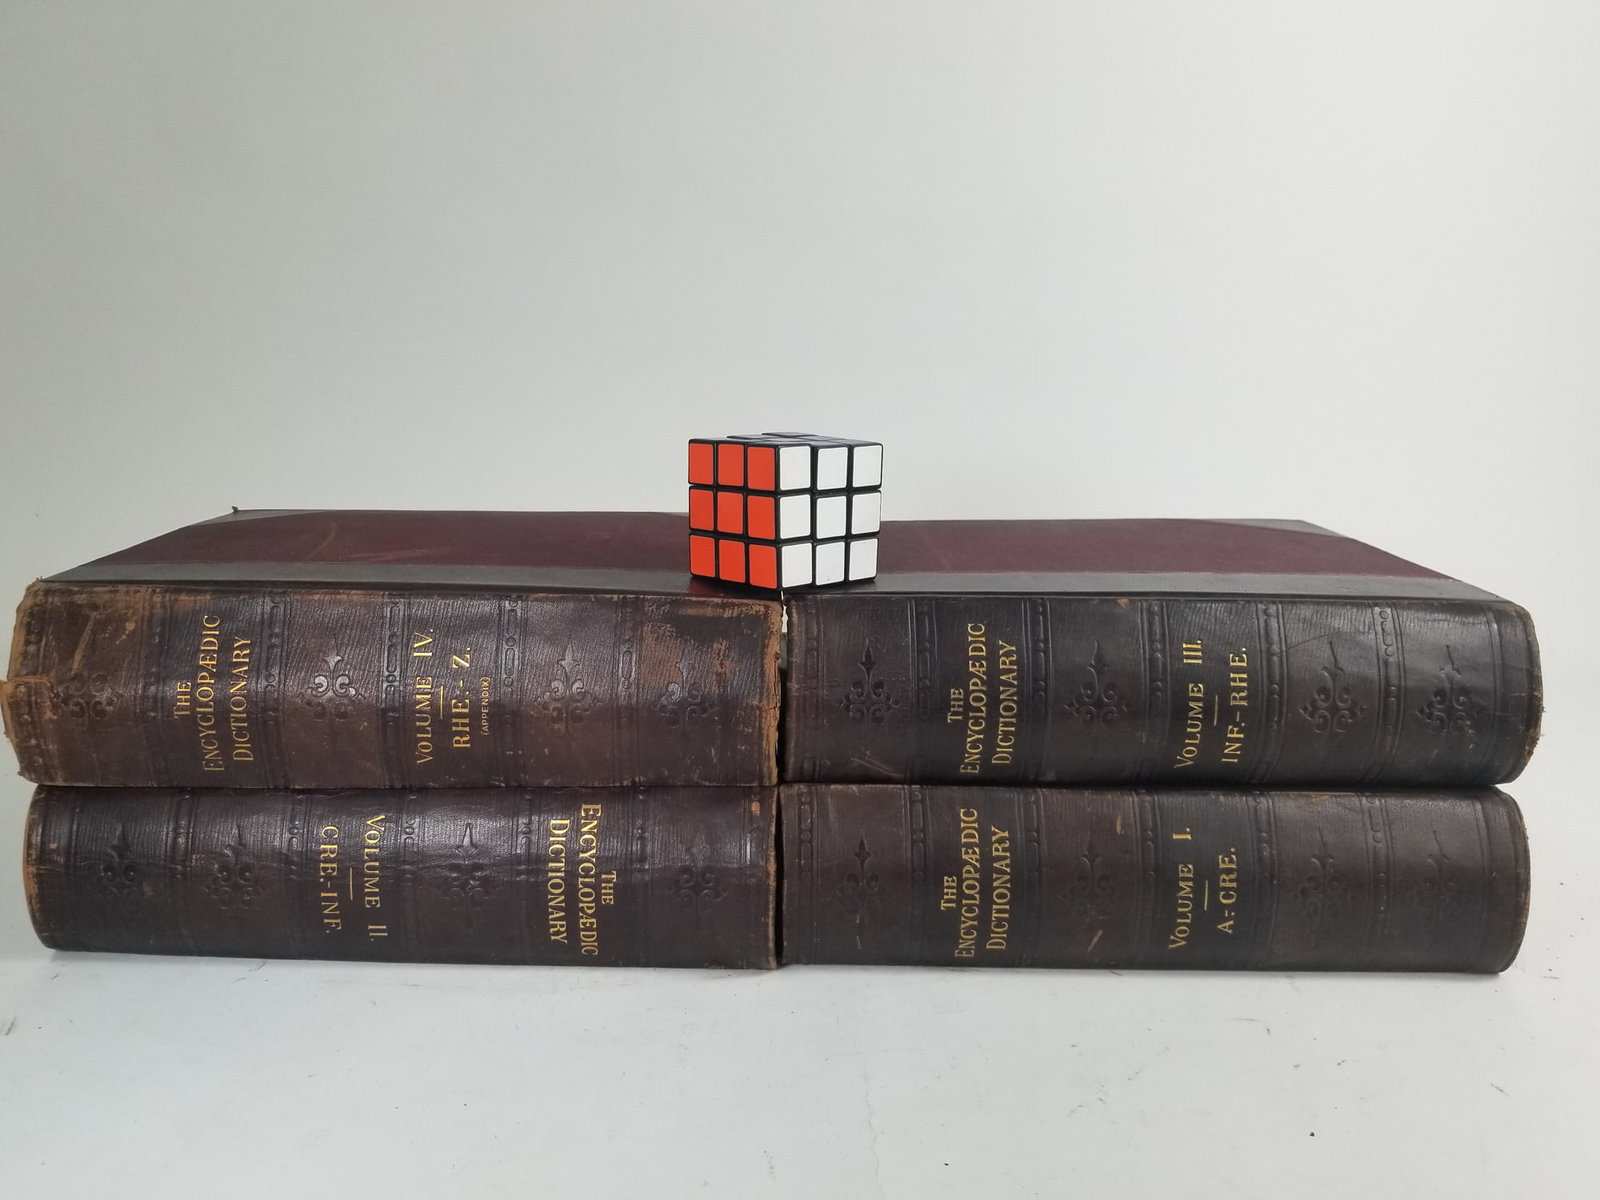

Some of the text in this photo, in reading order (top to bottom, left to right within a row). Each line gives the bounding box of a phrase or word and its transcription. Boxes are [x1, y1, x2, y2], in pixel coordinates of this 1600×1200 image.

[174, 681, 191, 719] THE
[230, 636, 253, 761] DICTIONARY
[415, 676, 434, 764] VOLUME
[480, 675, 491, 736] (APPENDIX)
[948, 688, 964, 723] THE
[991, 639, 1018, 764] DICTIONARY
[1173, 683, 1204, 769] VOLUME
[364, 814, 385, 908] VOLUME
[548, 819, 570, 944] DICTIONARY
[601, 870, 617, 905] THE
[940, 875, 957, 911] THE
[986, 825, 1011, 950] DICTIONARY
[1168, 864, 1194, 949] VOLUME
